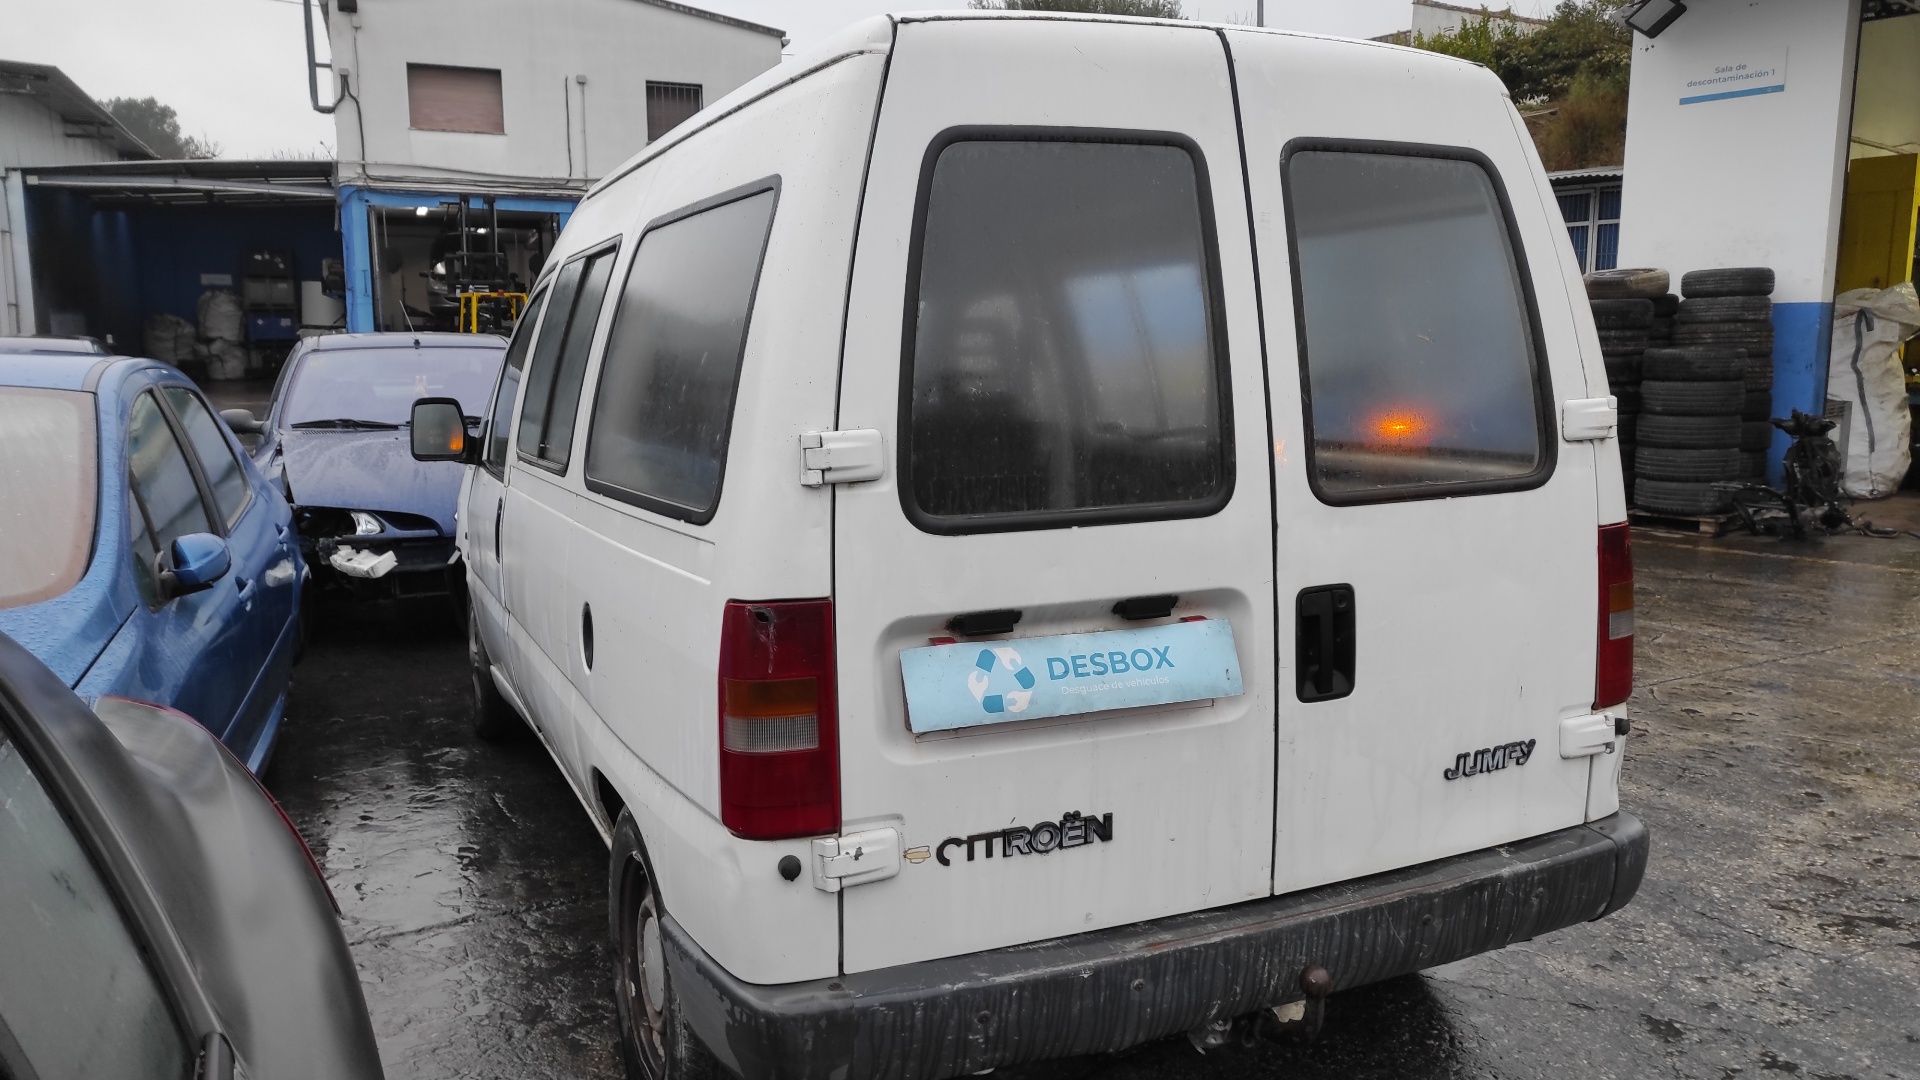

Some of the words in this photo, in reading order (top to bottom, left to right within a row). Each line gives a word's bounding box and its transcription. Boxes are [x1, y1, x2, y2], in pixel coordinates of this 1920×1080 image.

[1687, 70, 1769, 87] descontaminación
[1715, 64, 1733, 74] Sala
[1735, 63, 1747, 71] de
[1046, 646, 1175, 680] DESBOX
[1061, 682, 1110, 695] Desguace
[1111, 680, 1124, 689] de
[1443, 738, 1536, 780] JUMPY
[936, 810, 1113, 866] CITROËN
